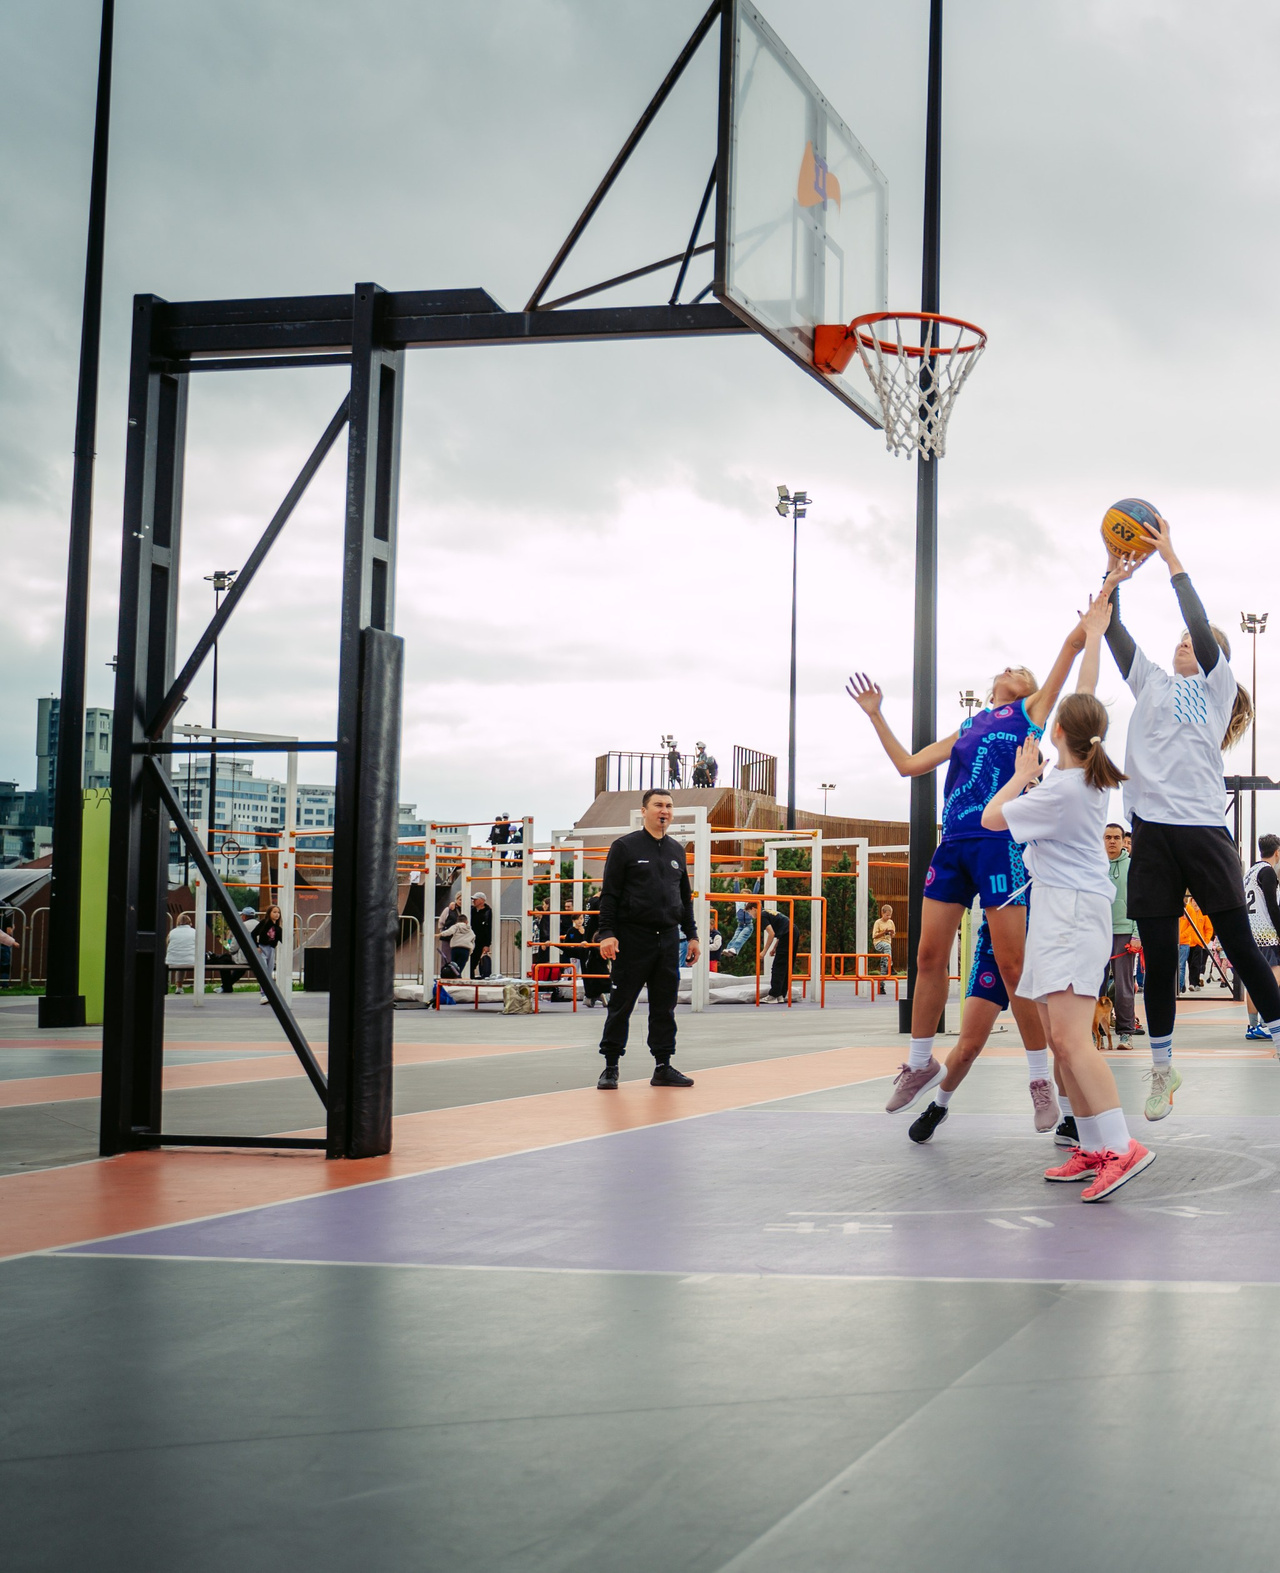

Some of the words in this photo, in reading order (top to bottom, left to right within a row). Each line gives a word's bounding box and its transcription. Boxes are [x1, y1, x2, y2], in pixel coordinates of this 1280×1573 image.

[962, 746, 988, 793] running
[982, 731, 1018, 744] team
[989, 873, 1008, 894] 10
